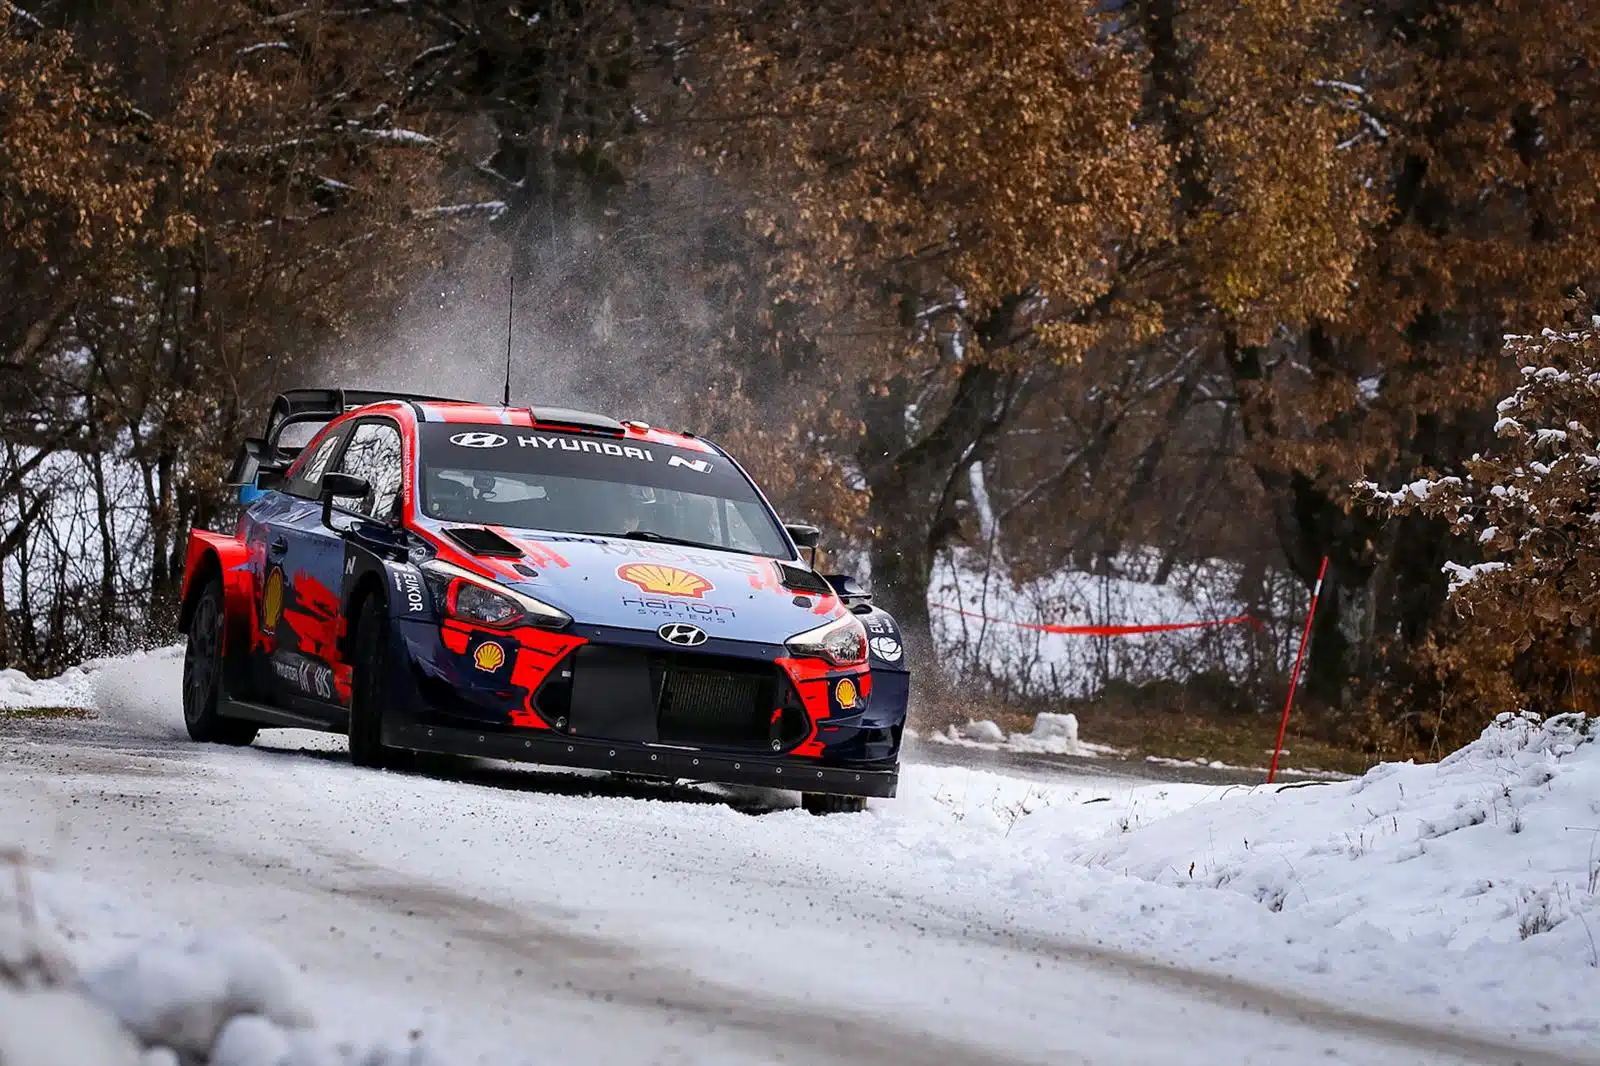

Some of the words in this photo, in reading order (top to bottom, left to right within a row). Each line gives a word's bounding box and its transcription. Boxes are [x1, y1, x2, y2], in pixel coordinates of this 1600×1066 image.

[517, 435, 654, 461] HYUNDAI
[667, 455, 714, 474] N
[345, 555, 357, 575] N
[402, 573, 424, 612] EUKOR
[636, 607, 727, 625] SYSTEMS
